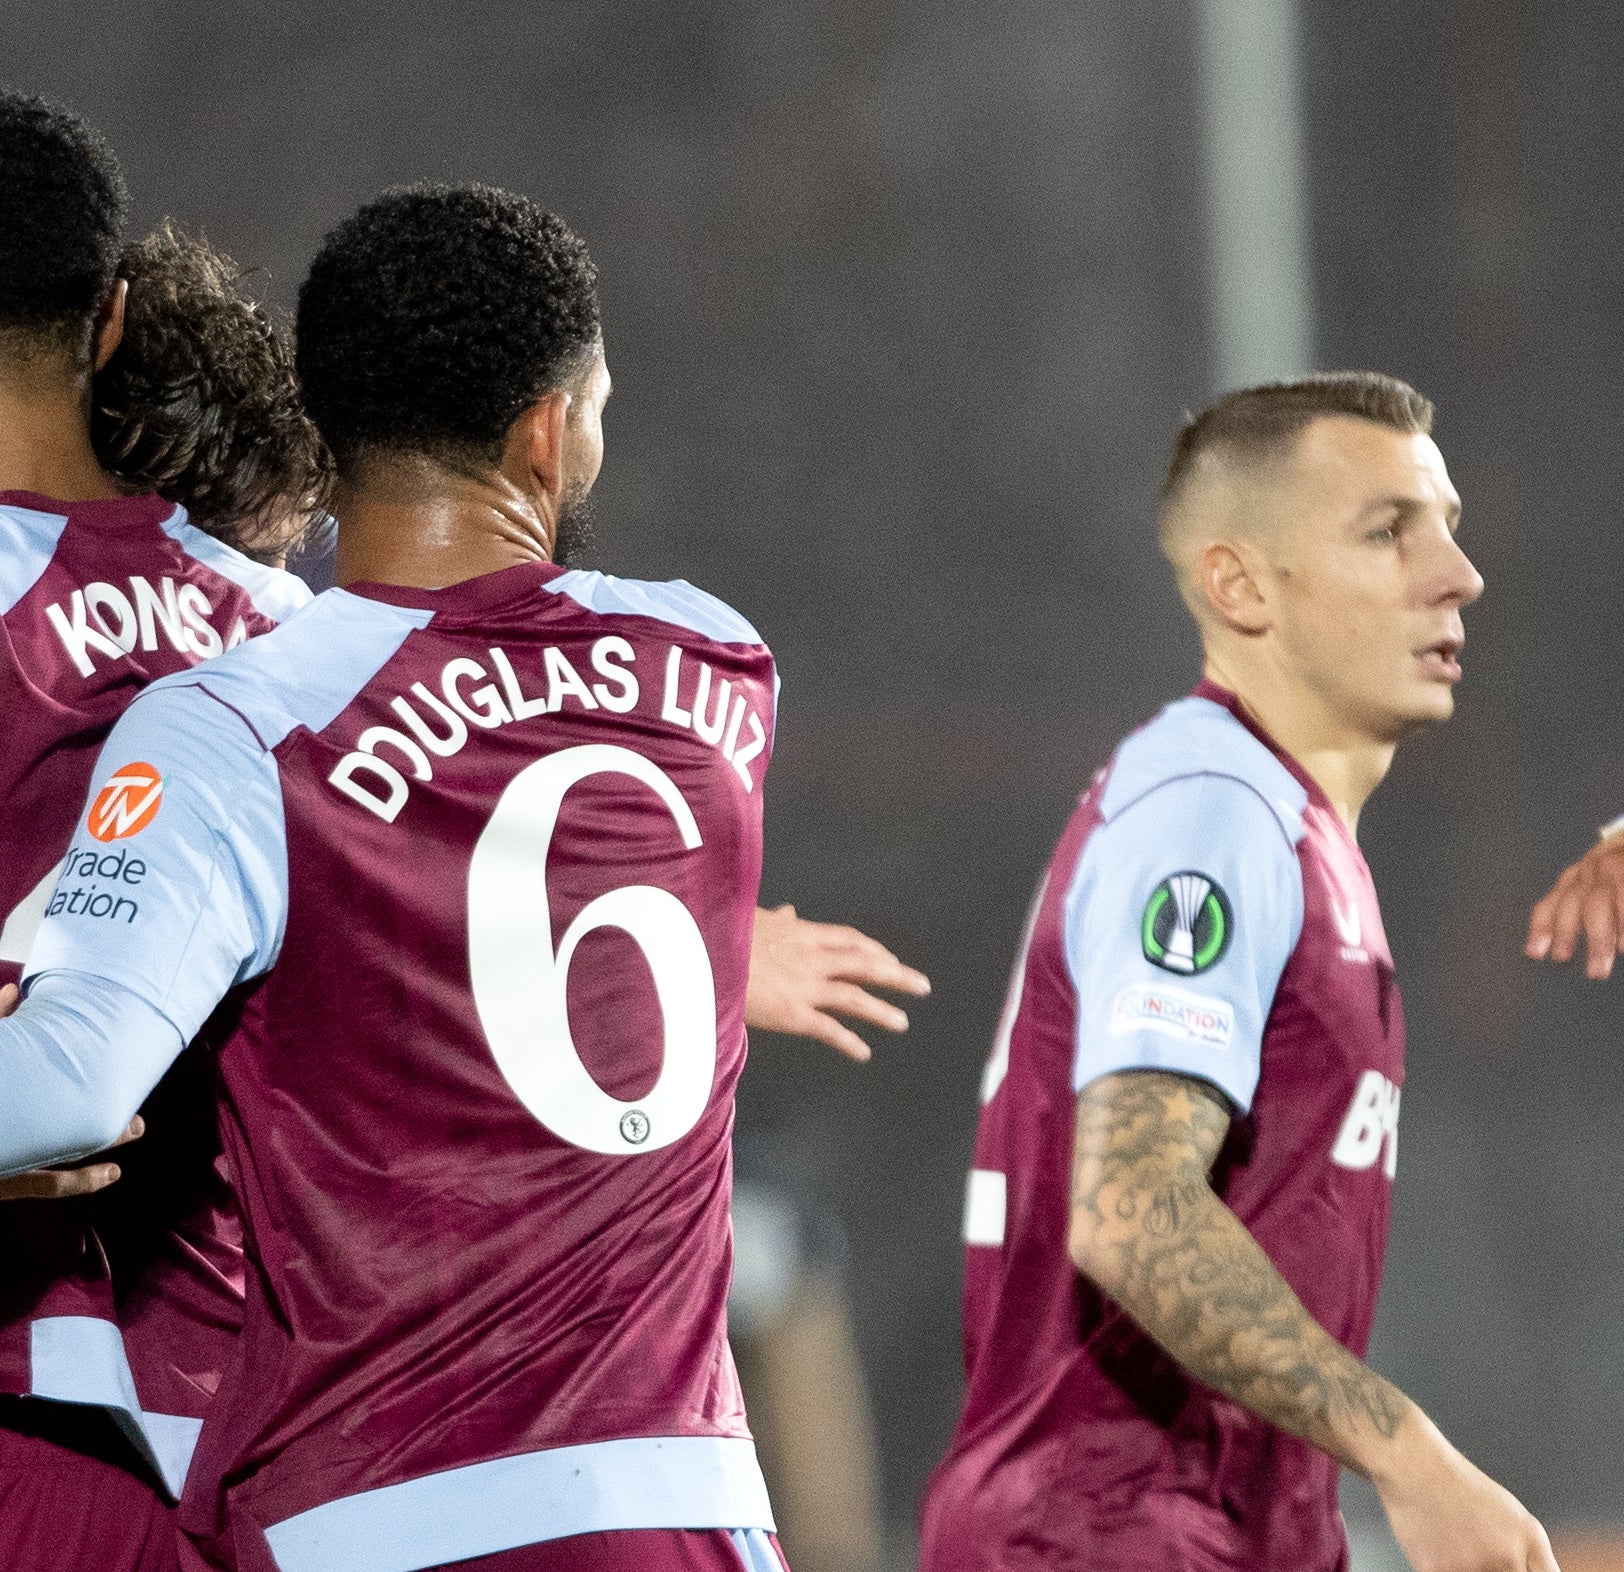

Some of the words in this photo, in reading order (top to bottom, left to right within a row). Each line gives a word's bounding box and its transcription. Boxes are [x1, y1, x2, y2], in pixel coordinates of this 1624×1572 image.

[328, 636, 640, 824] DOUGLAS
[662, 645, 767, 794] LUIZ
[467, 744, 717, 1155] 6
